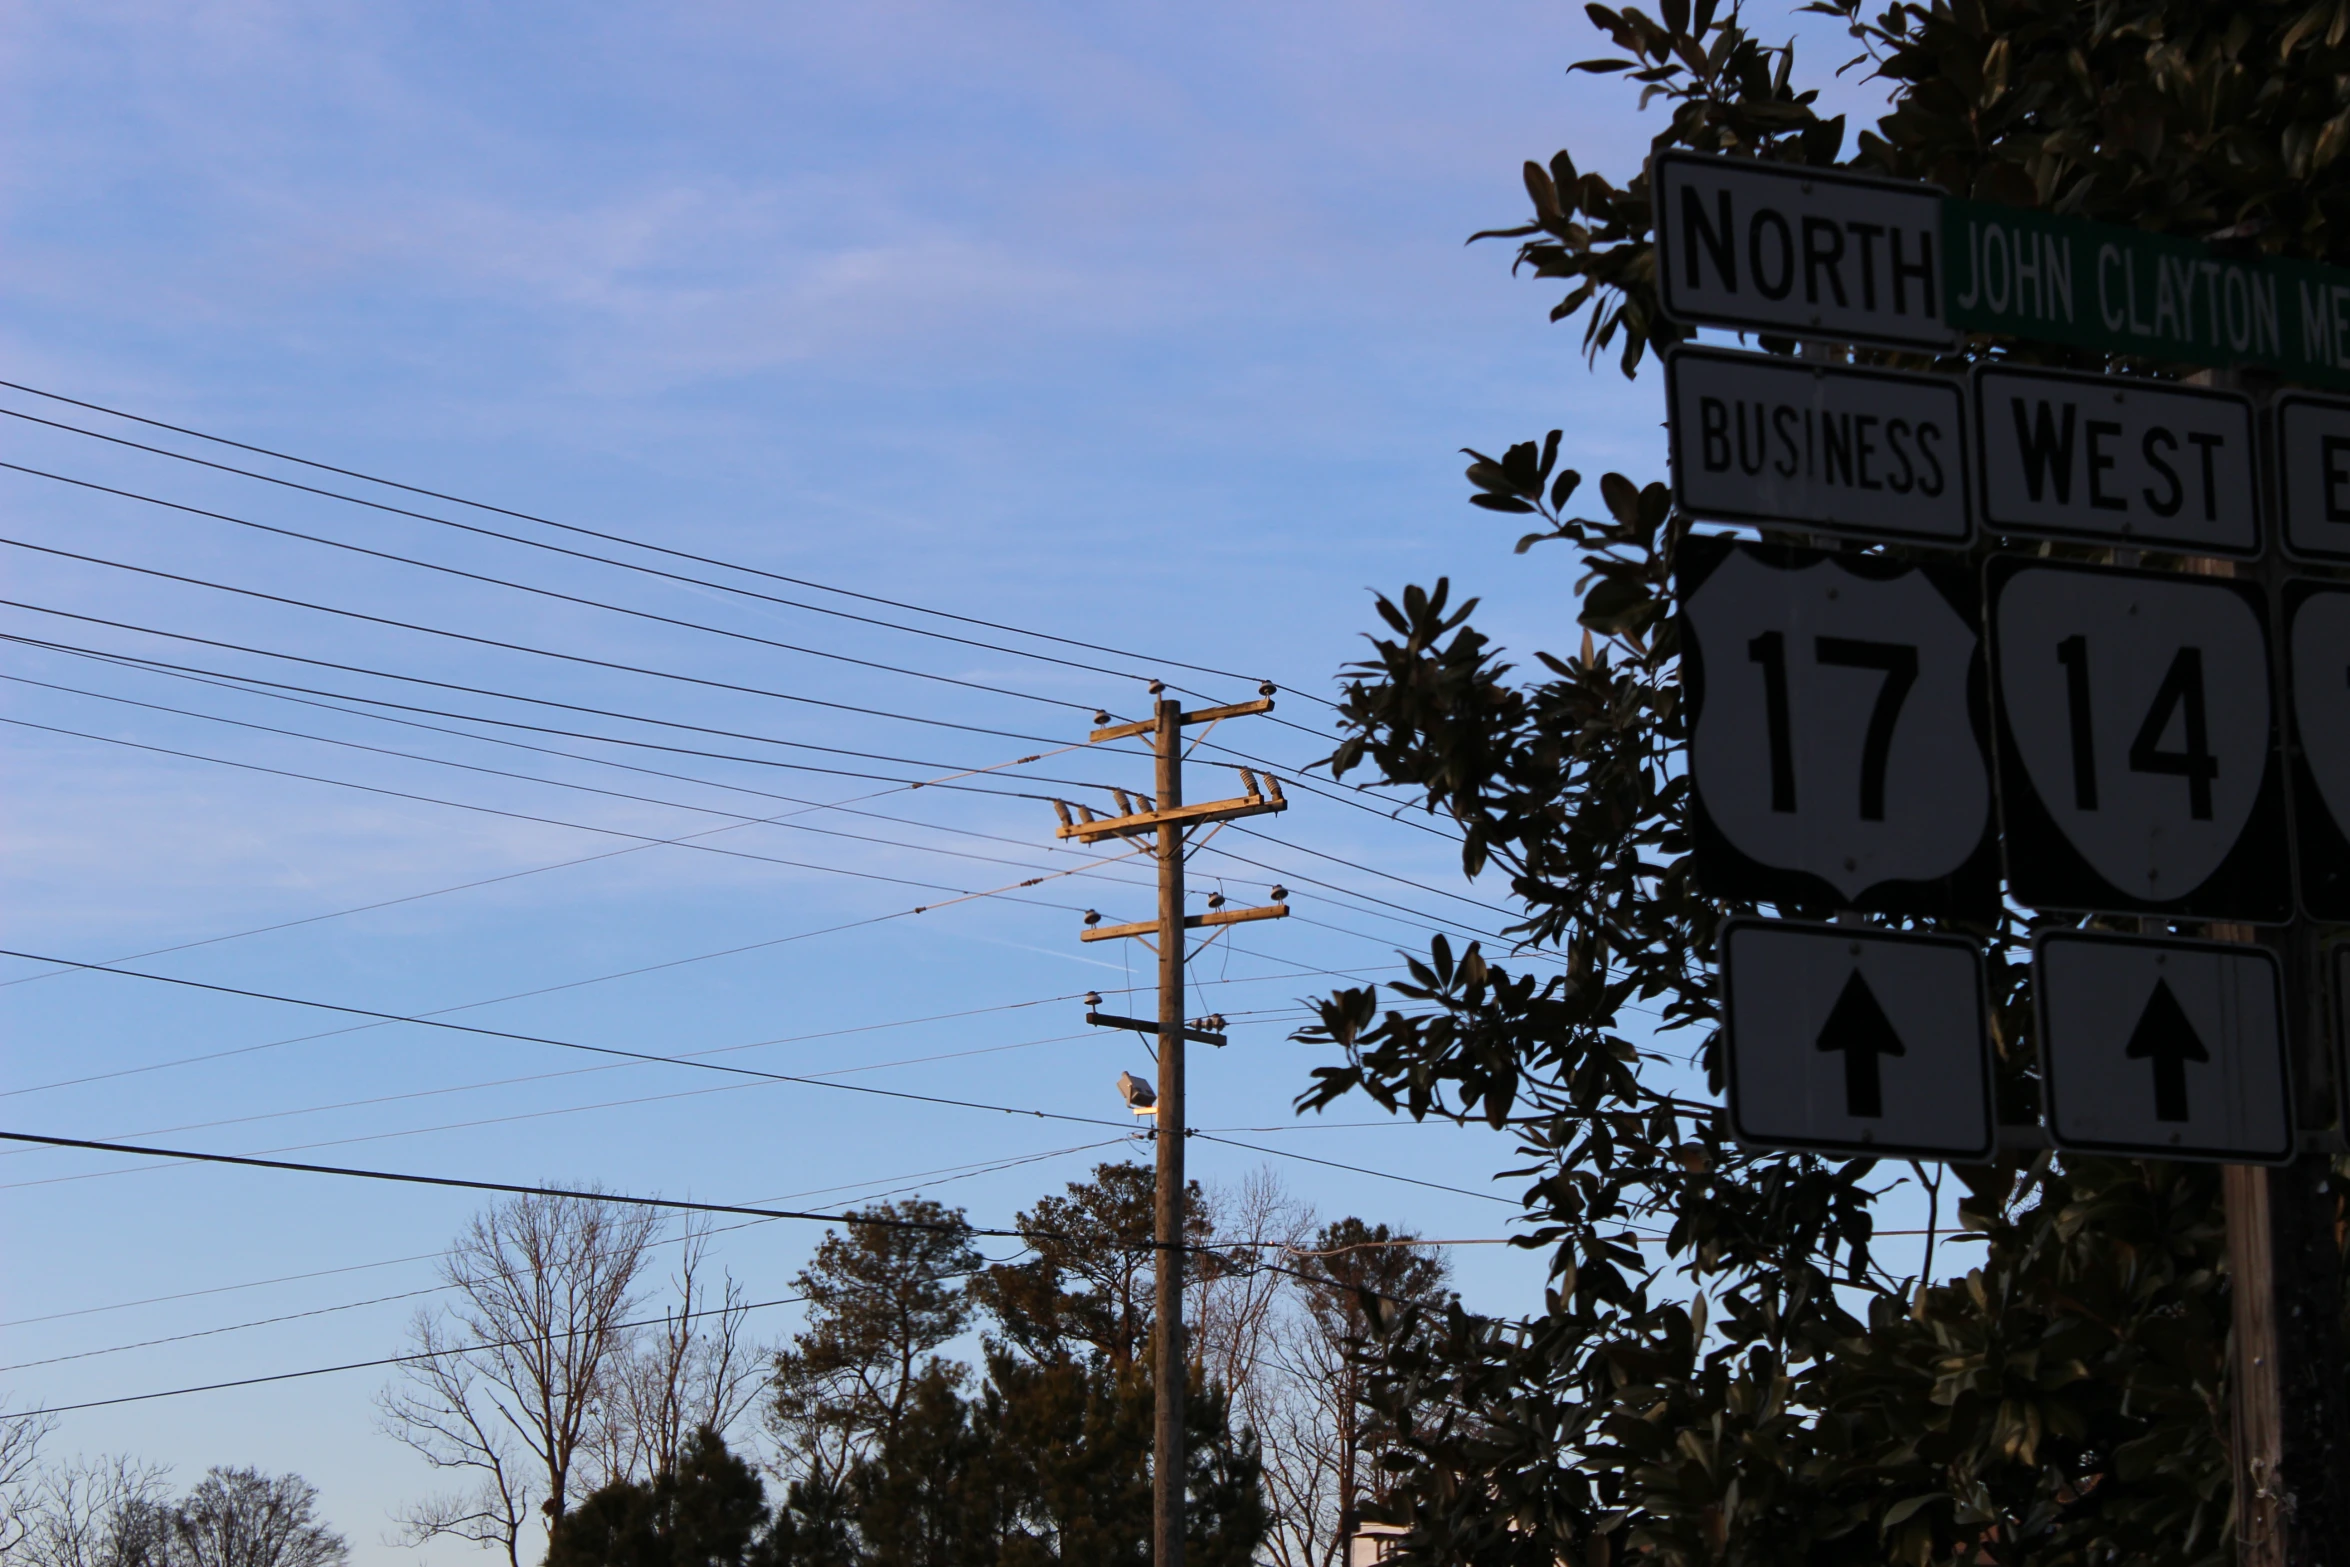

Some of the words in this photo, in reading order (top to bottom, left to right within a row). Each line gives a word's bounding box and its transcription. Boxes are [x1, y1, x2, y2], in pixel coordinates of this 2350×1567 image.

[1681, 185, 1936, 318] NORTH
[1957, 219, 2074, 325] JOHN
[2099, 243, 2282, 359] CLAYTON
[1701, 397, 1943, 497] BUSINESS
[2012, 397, 2224, 521] WEST
[1748, 631, 1918, 821] 17
[2057, 635, 2218, 820] 14
